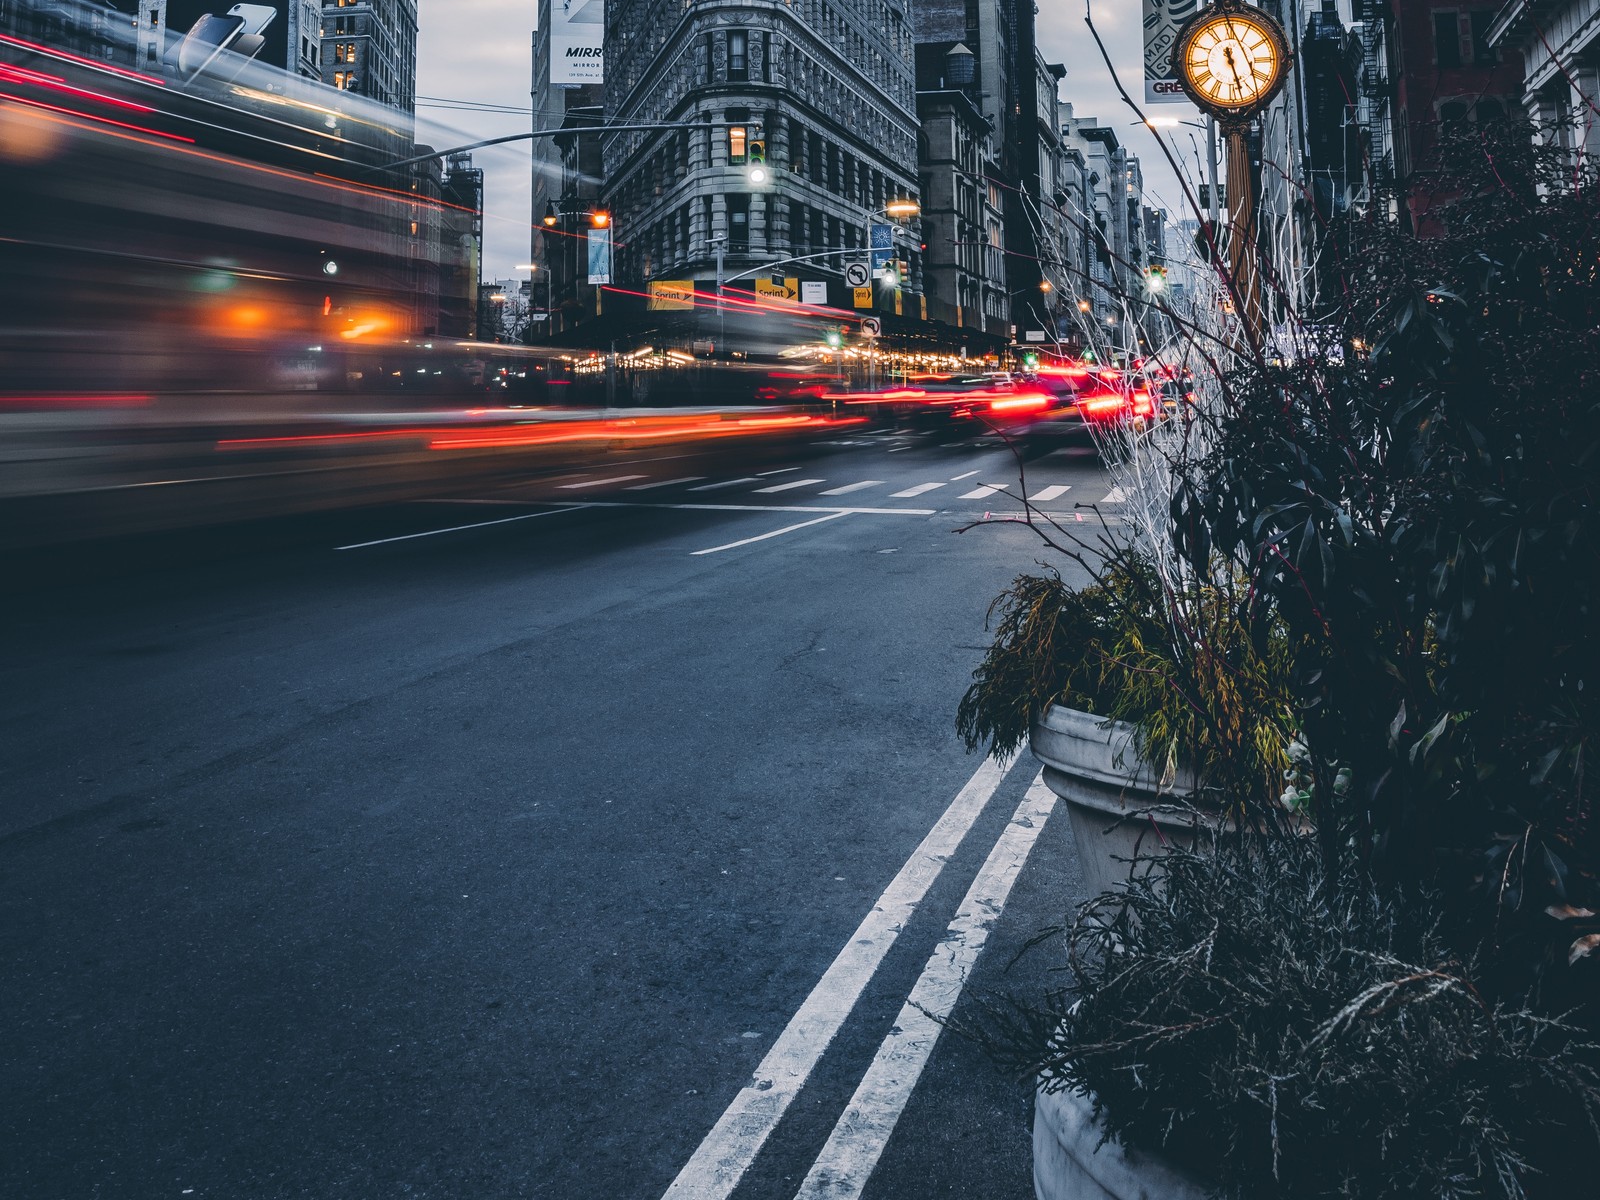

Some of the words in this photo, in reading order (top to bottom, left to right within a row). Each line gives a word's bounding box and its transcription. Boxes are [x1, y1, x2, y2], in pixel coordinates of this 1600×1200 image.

[1144, 34, 1175, 62] MAD.
[655, 291, 680, 301] Sprint
[758, 289, 784, 299] Sprint
[855, 289, 867, 299] Sprint
